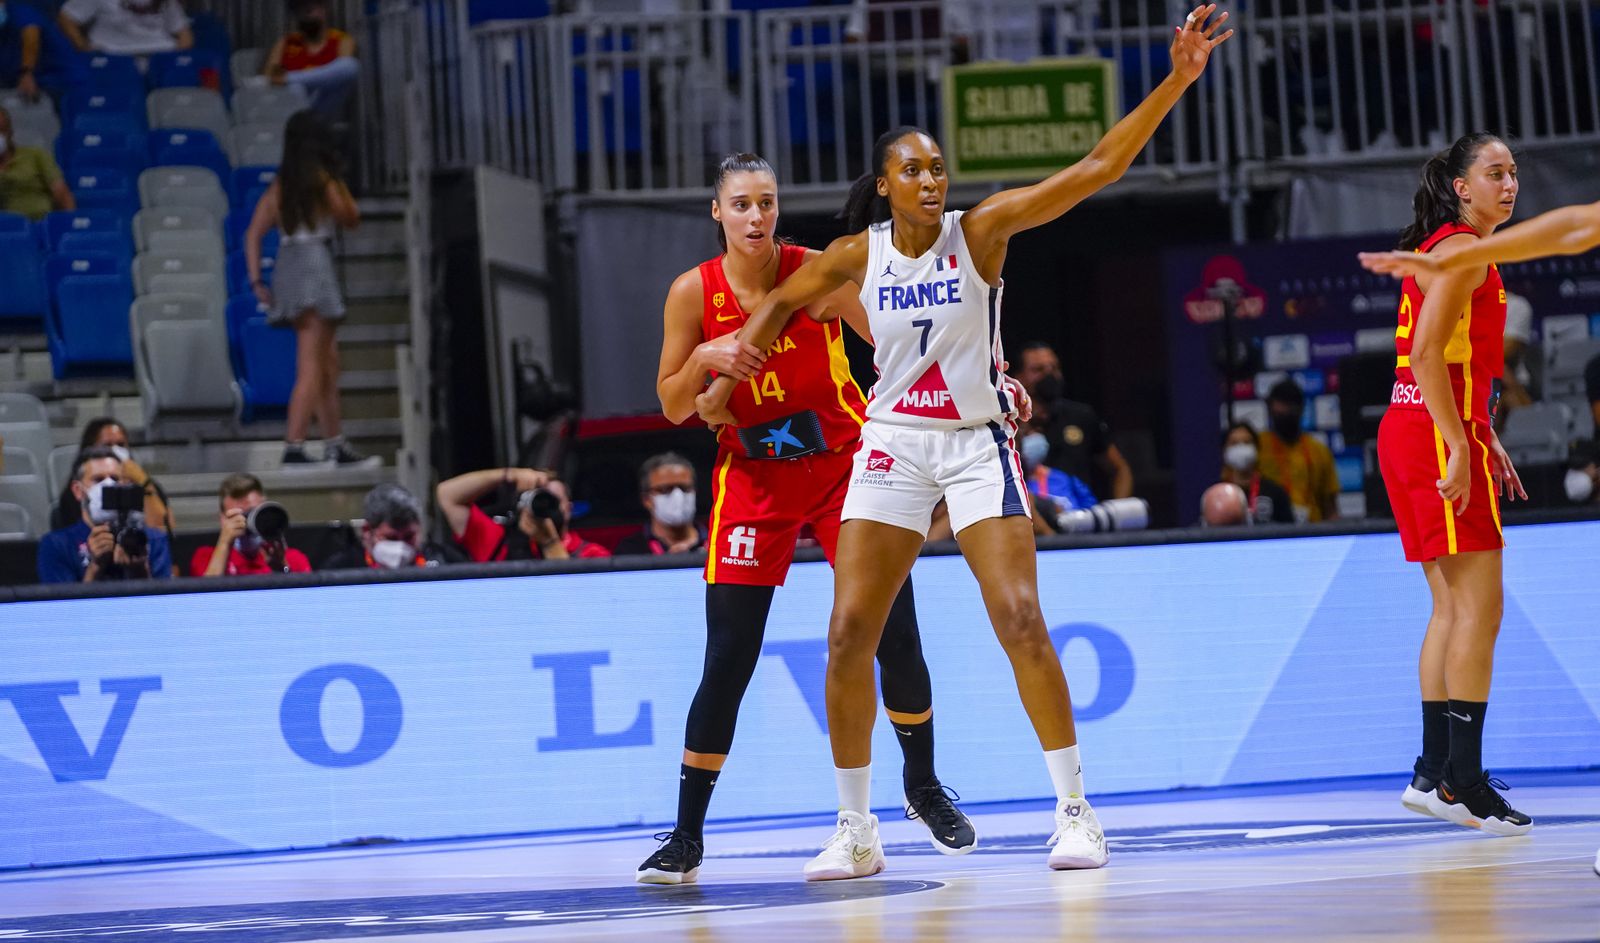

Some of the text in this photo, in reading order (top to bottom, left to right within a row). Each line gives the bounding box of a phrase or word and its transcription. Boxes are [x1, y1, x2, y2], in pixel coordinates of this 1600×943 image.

[965, 82, 1095, 120] SALIDA DE
[878, 278, 962, 311] FRANCE
[912, 319, 933, 357] 7
[748, 371, 786, 405] 14
[902, 390, 951, 408] MAIF
[862, 472, 886, 480] CAISSE
[728, 526, 756, 559] fi
[721, 556, 759, 567] network
[0, 622, 1137, 783] VOLVO
